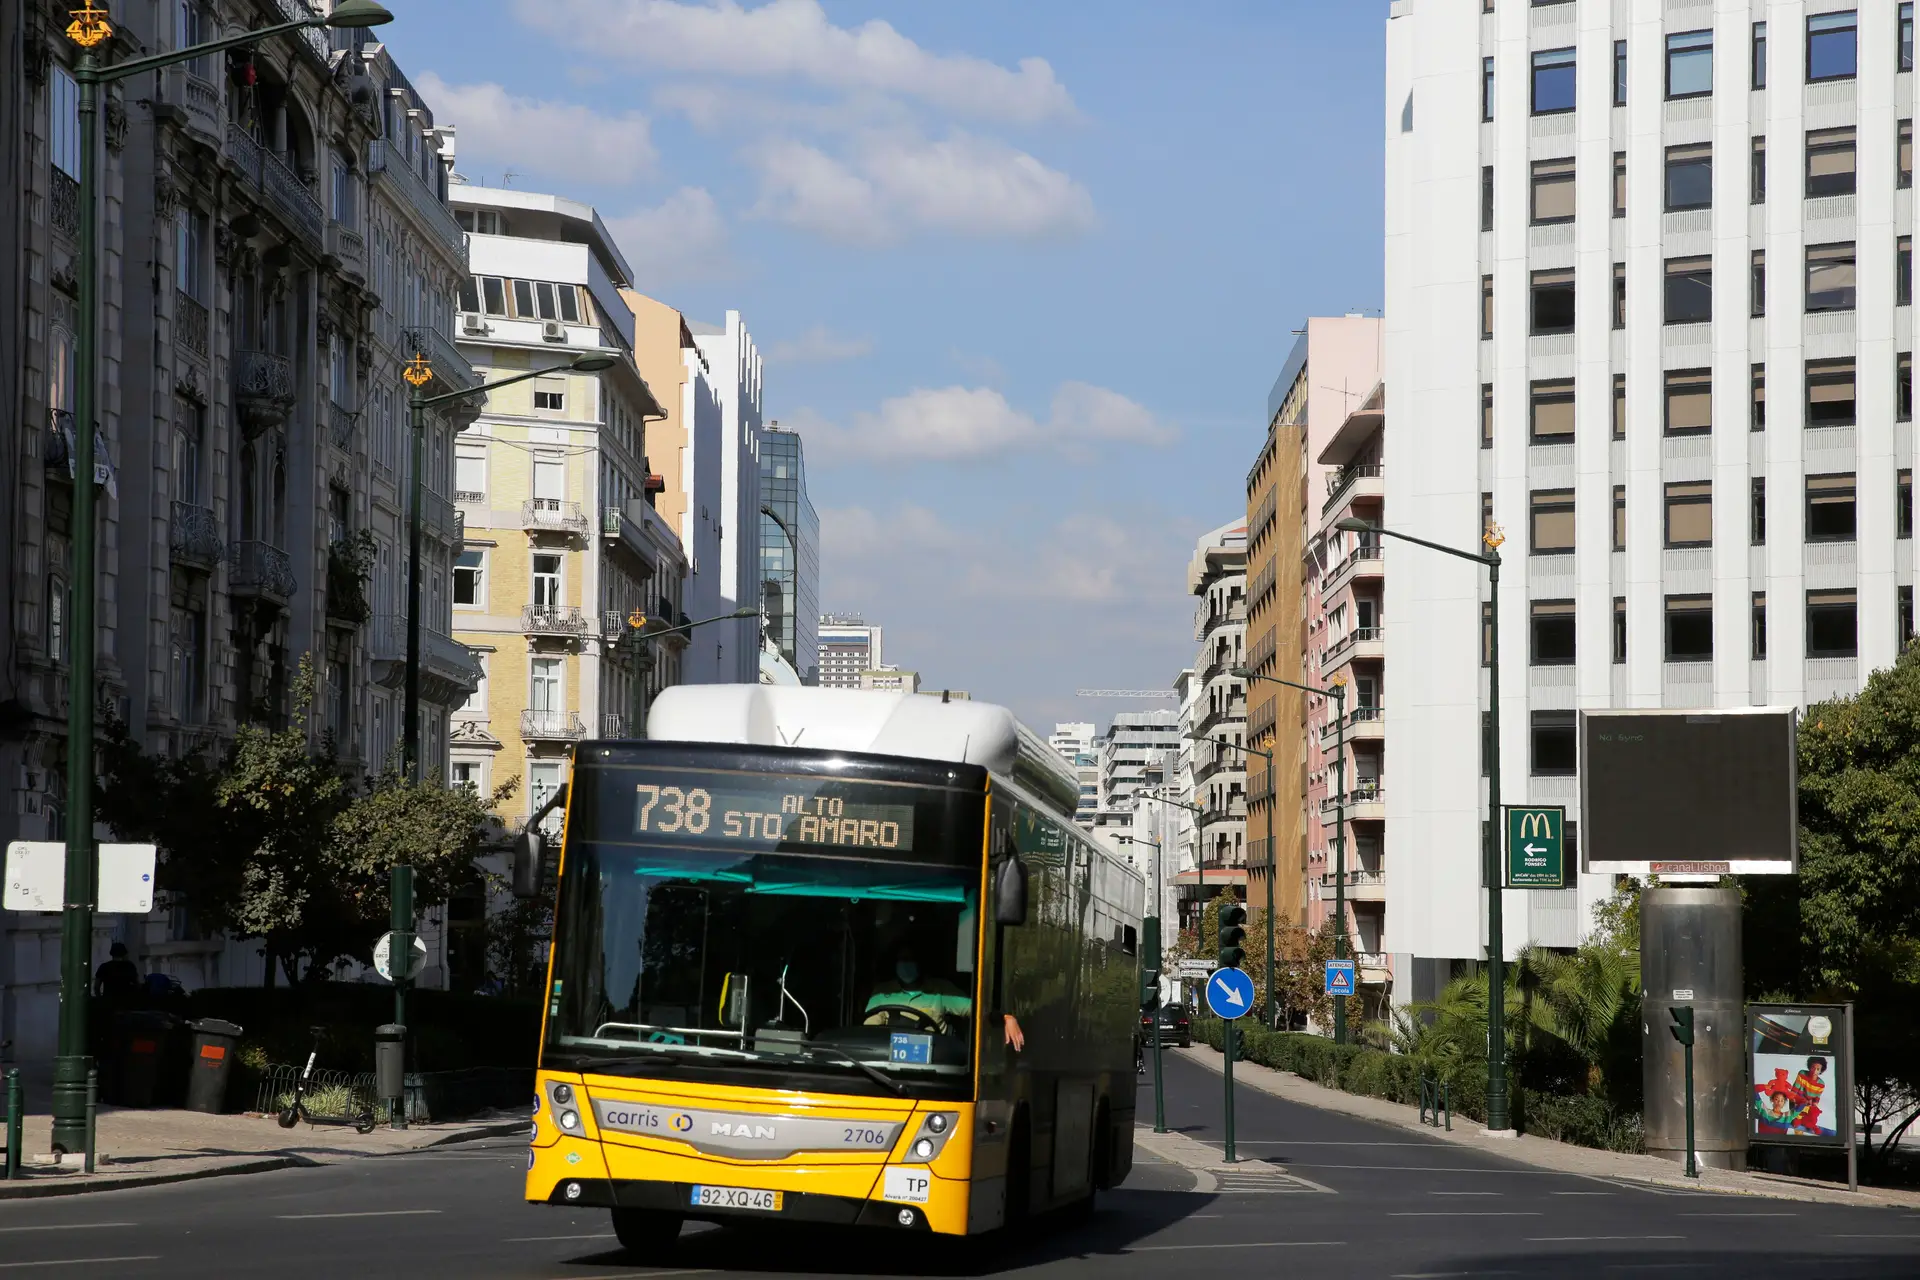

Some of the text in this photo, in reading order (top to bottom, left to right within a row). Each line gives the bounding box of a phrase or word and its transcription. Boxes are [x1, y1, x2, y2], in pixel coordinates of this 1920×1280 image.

[637, 784, 843, 834] 738 ALTO
[723, 810, 899, 848] STO. AMARO
[1667, 862, 1694, 872] canal
[893, 1036, 908, 1044] 738
[893, 1049, 907, 1059] 10
[607, 1109, 885, 1145] carris MAN 2706
[906, 1177, 928, 1192] TP
